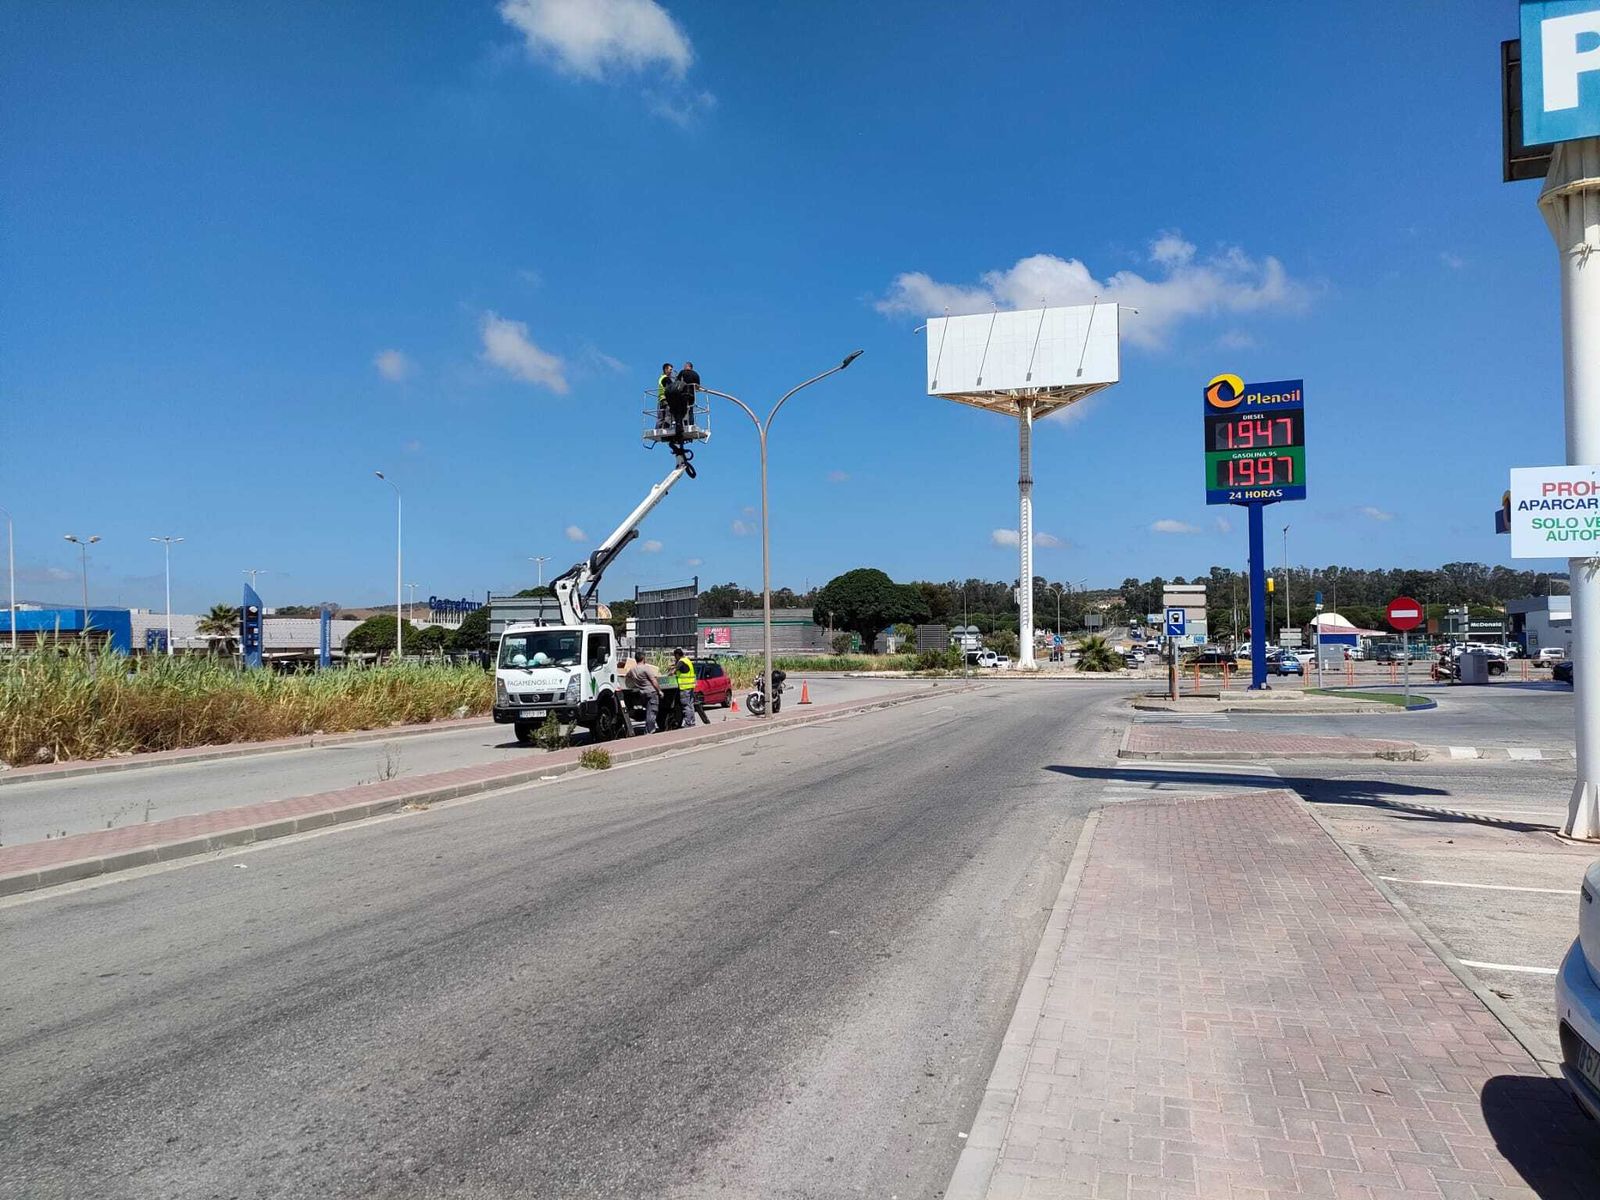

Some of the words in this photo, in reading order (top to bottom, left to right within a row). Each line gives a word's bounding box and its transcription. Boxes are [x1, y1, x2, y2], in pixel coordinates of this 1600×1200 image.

[1247, 389, 1300, 405] Plenoil
[1228, 419, 1292, 448] 1.947
[1229, 457, 1292, 486] 1.997
[1229, 491, 1242, 500] 24
[1245, 489, 1283, 499] HORAS
[1518, 499, 1598, 511] APARCAR
[1531, 517, 1579, 529] SOLO
[429, 596, 482, 611] Carrefour
